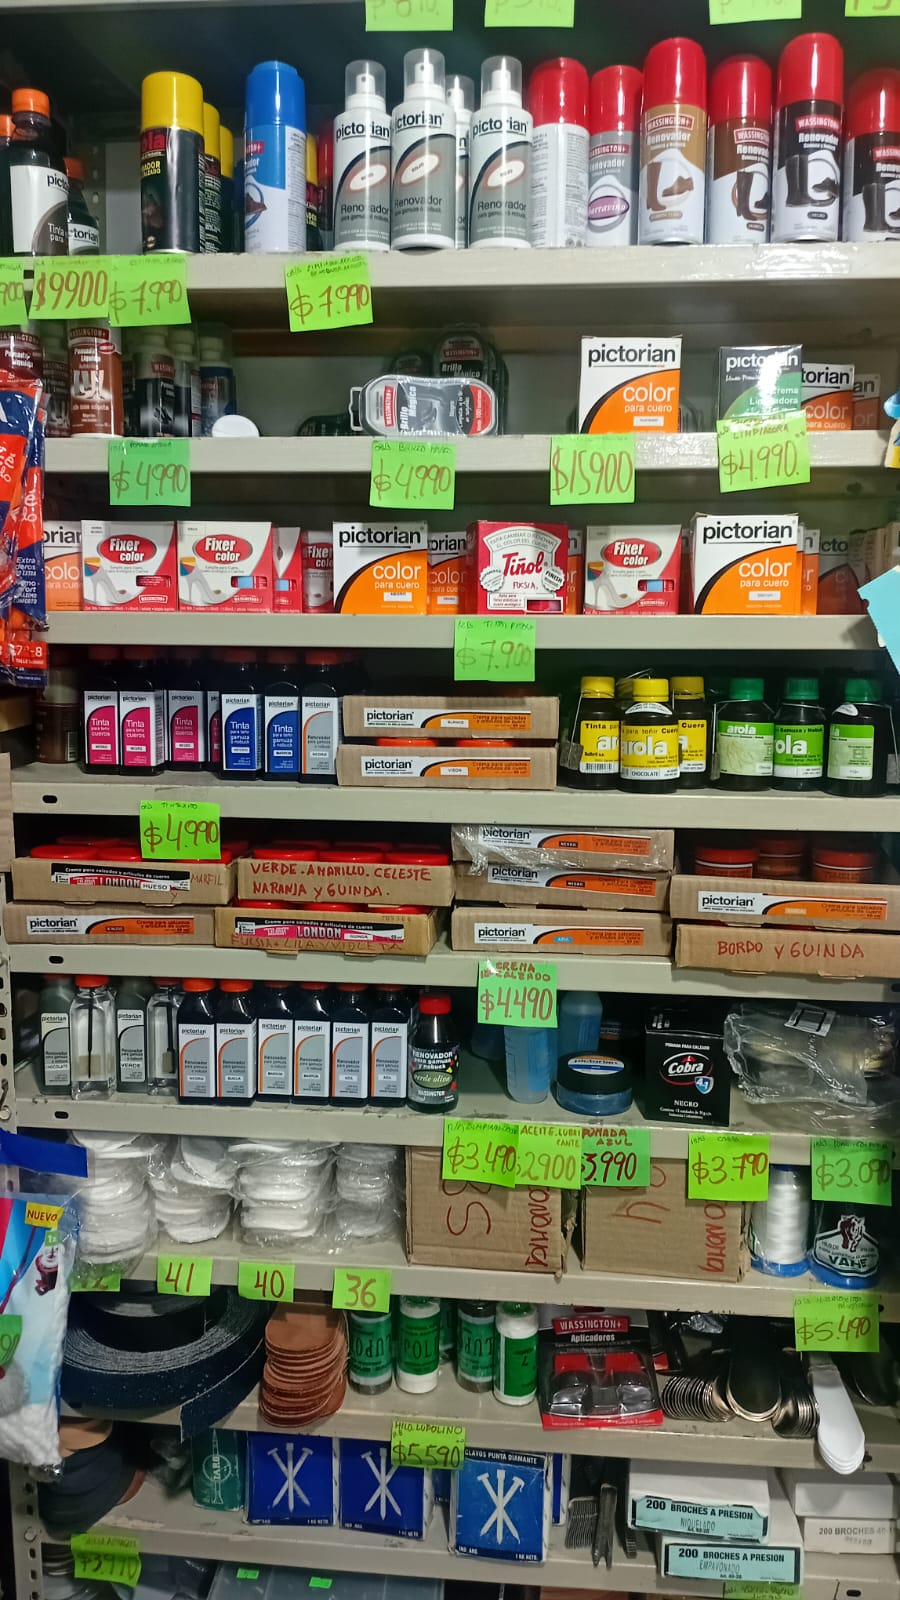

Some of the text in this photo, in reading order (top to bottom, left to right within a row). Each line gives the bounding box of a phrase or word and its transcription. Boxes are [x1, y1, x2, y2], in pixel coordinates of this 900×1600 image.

[588, 344, 677, 367] pictorian
[623, 384, 675, 402] color
[624, 404, 672, 414] para cuero
[340, 526, 421, 547] pictorian
[703, 520, 793, 544] pictorian
[109, 538, 140, 553] Fixer
[205, 538, 236, 552] Fixer
[614, 542, 644, 555] Fixer
[119, 550, 145, 562] color
[215, 551, 240, 562] color
[623, 556, 649, 566] color
[373, 561, 421, 580] color
[502, 551, 545, 577] Tiñol
[739, 558, 792, 577] color
[374, 582, 394, 590] para
[91, 718, 110, 726] Tinta
[175, 718, 193, 726] Tinta
[366, 710, 414, 723] pictorian
[126, 719, 145, 728] Tinta
[230, 721, 250, 730] Tinta
[273, 725, 293, 733] Tinta
[727, 725, 757, 735] arola
[365, 759, 412, 772] pictorian
[483, 828, 532, 840] pictorian
[374, 867, 432, 881] CELESTE
[491, 866, 539, 878] pictorian
[253, 881, 308, 897] NARANJA
[702, 895, 755, 907] pictorian
[30, 918, 78, 929] pictorian
[297, 926, 341, 939] LONDON
[478, 926, 526, 938] pictorian
[717, 941, 764, 956] BORDO
[790, 942, 865, 959] GUINDA
[496, 961, 536, 972] CREMA
[480, 986, 553, 1021] $4.490
[413, 1050, 453, 1059] RENOVADOR
[668, 1061, 704, 1074] Cobra
[674, 1100, 699, 1108] NEGRO
[583, 1128, 627, 1138] POMADA
[556, 1139, 579, 1148] CANTE
[597, 1138, 633, 1147] AZUL
[27, 1210, 58, 1222] NUEVO
[165, 1262, 195, 1293] 41
[255, 1270, 285, 1298] 40
[345, 1273, 377, 1308] 36
[571, 1333, 615, 1343] Aplicadores
[465, 1449, 537, 1464] CLAVOS PUNTA DIAMANTE
[646, 1499, 753, 1521] 200 BROCHES A PRESION
[680, 1517, 716, 1532] NIQUELADO
[819, 1528, 876, 1537] 200 BROCHES
[678, 1548, 785, 1563] 200 BROCHES A PRESION
[699, 1560, 741, 1573] EMPAVONADO
